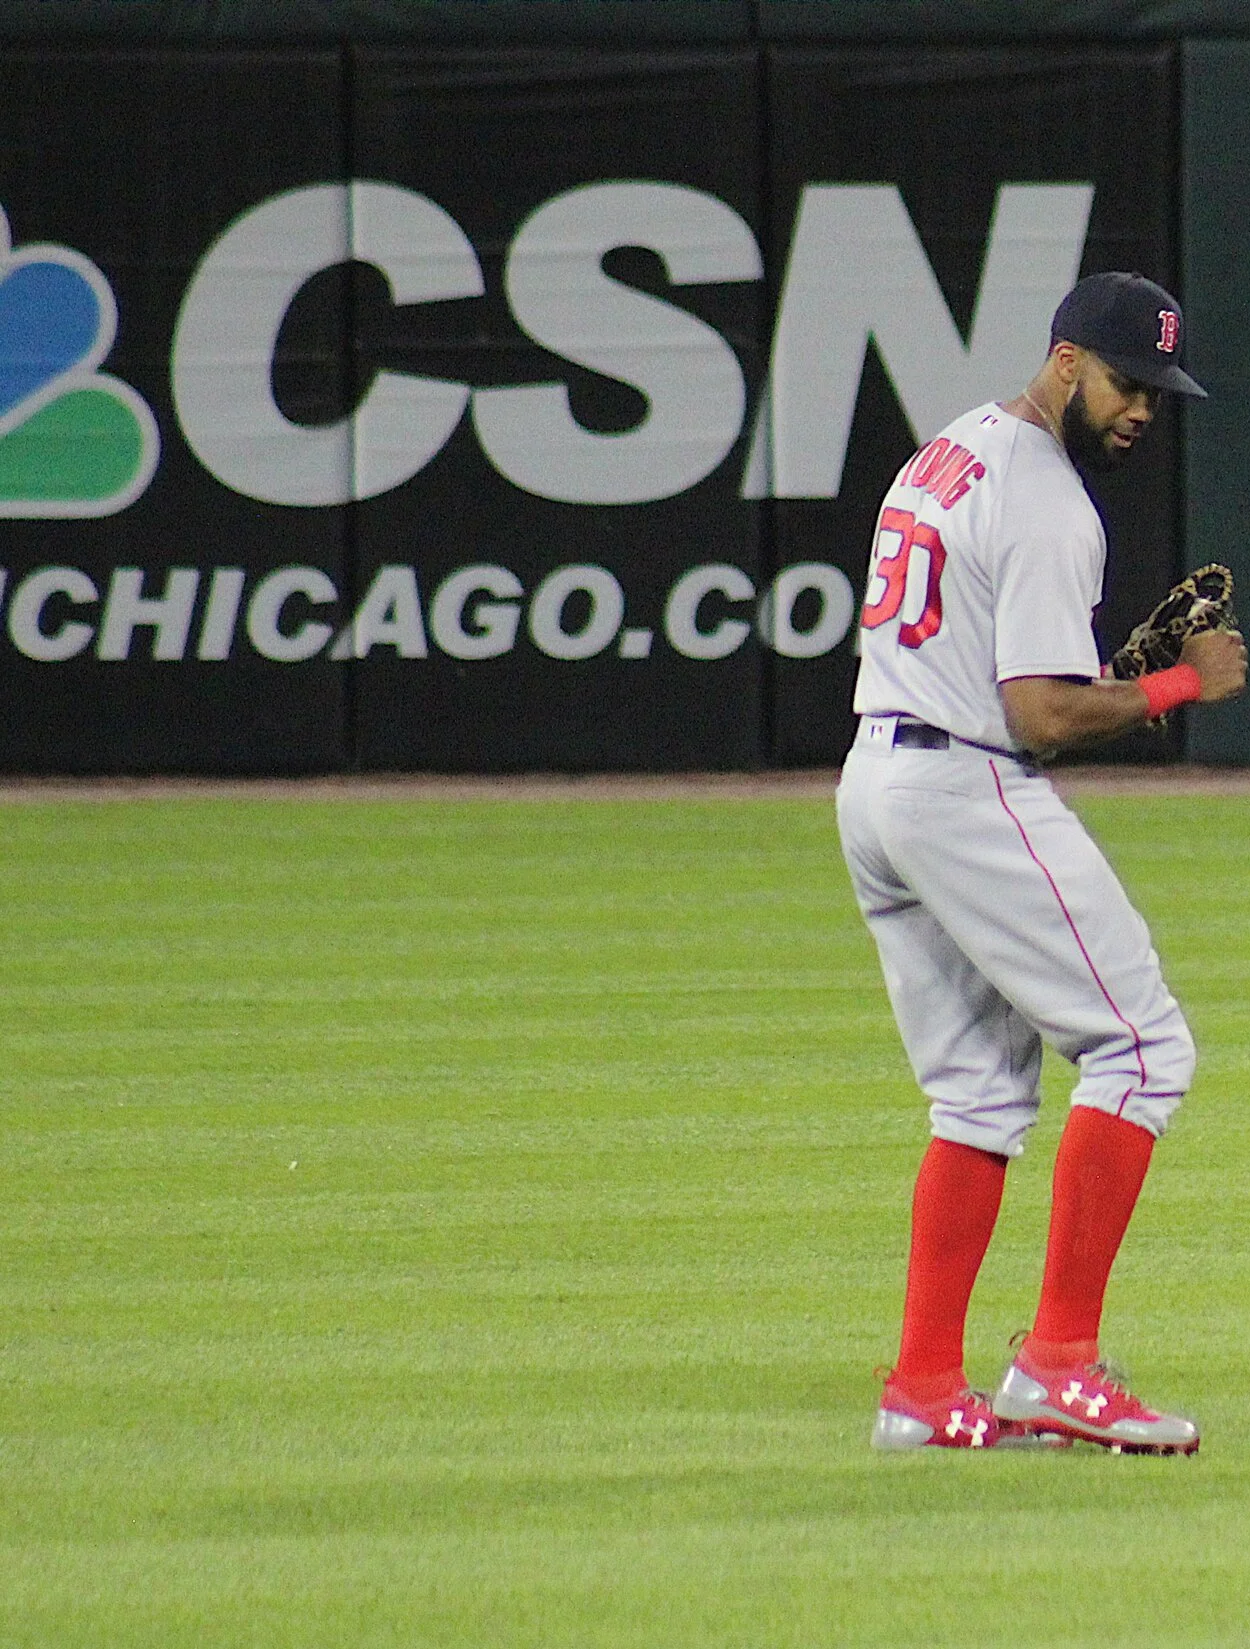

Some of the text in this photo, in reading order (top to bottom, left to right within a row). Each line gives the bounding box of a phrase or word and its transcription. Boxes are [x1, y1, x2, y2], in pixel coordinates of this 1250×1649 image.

[172, 179, 1096, 506] CSN
[1156, 310, 1180, 353] B
[0, 562, 861, 662] CHICAGO.CO
[861, 506, 947, 650] 30
